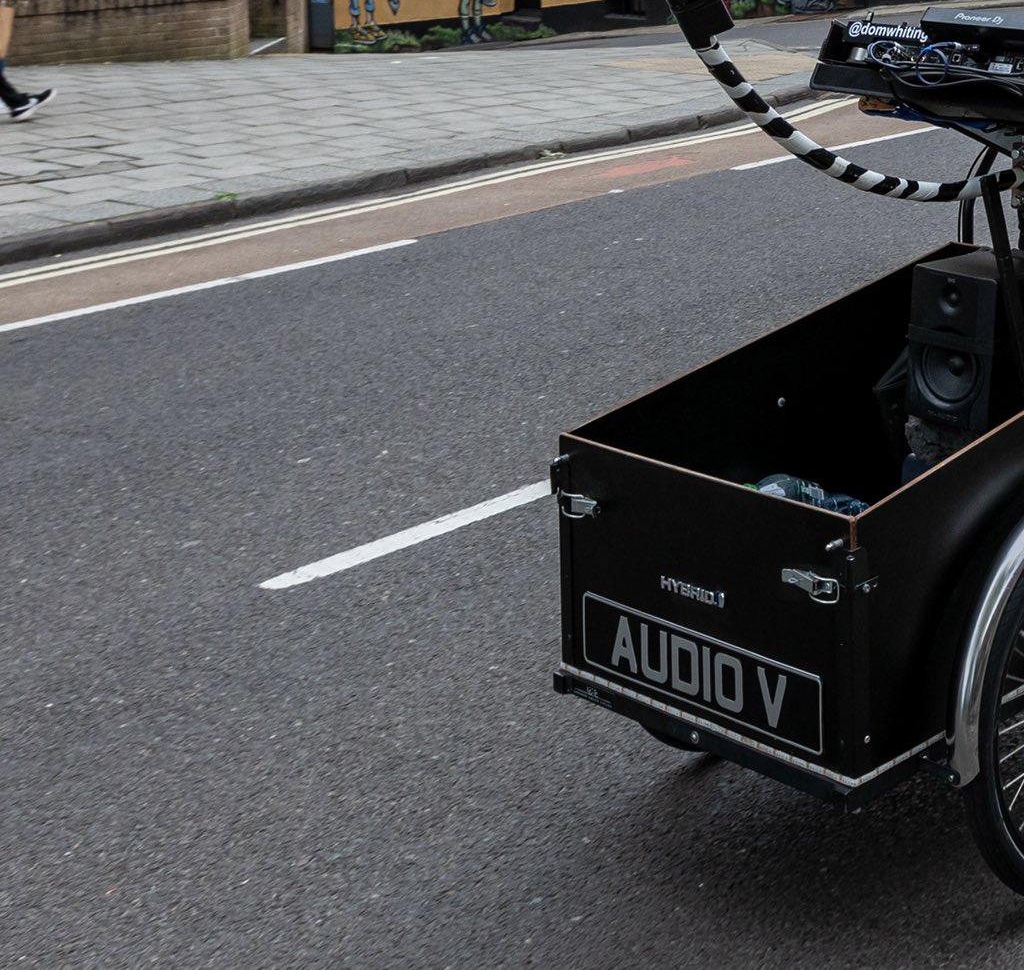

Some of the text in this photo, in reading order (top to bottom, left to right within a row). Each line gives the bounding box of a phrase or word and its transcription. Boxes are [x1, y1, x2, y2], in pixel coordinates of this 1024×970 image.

[954, 12, 1003, 25] Pioneer DJ
[611, 615, 787, 729] AUDIO V
